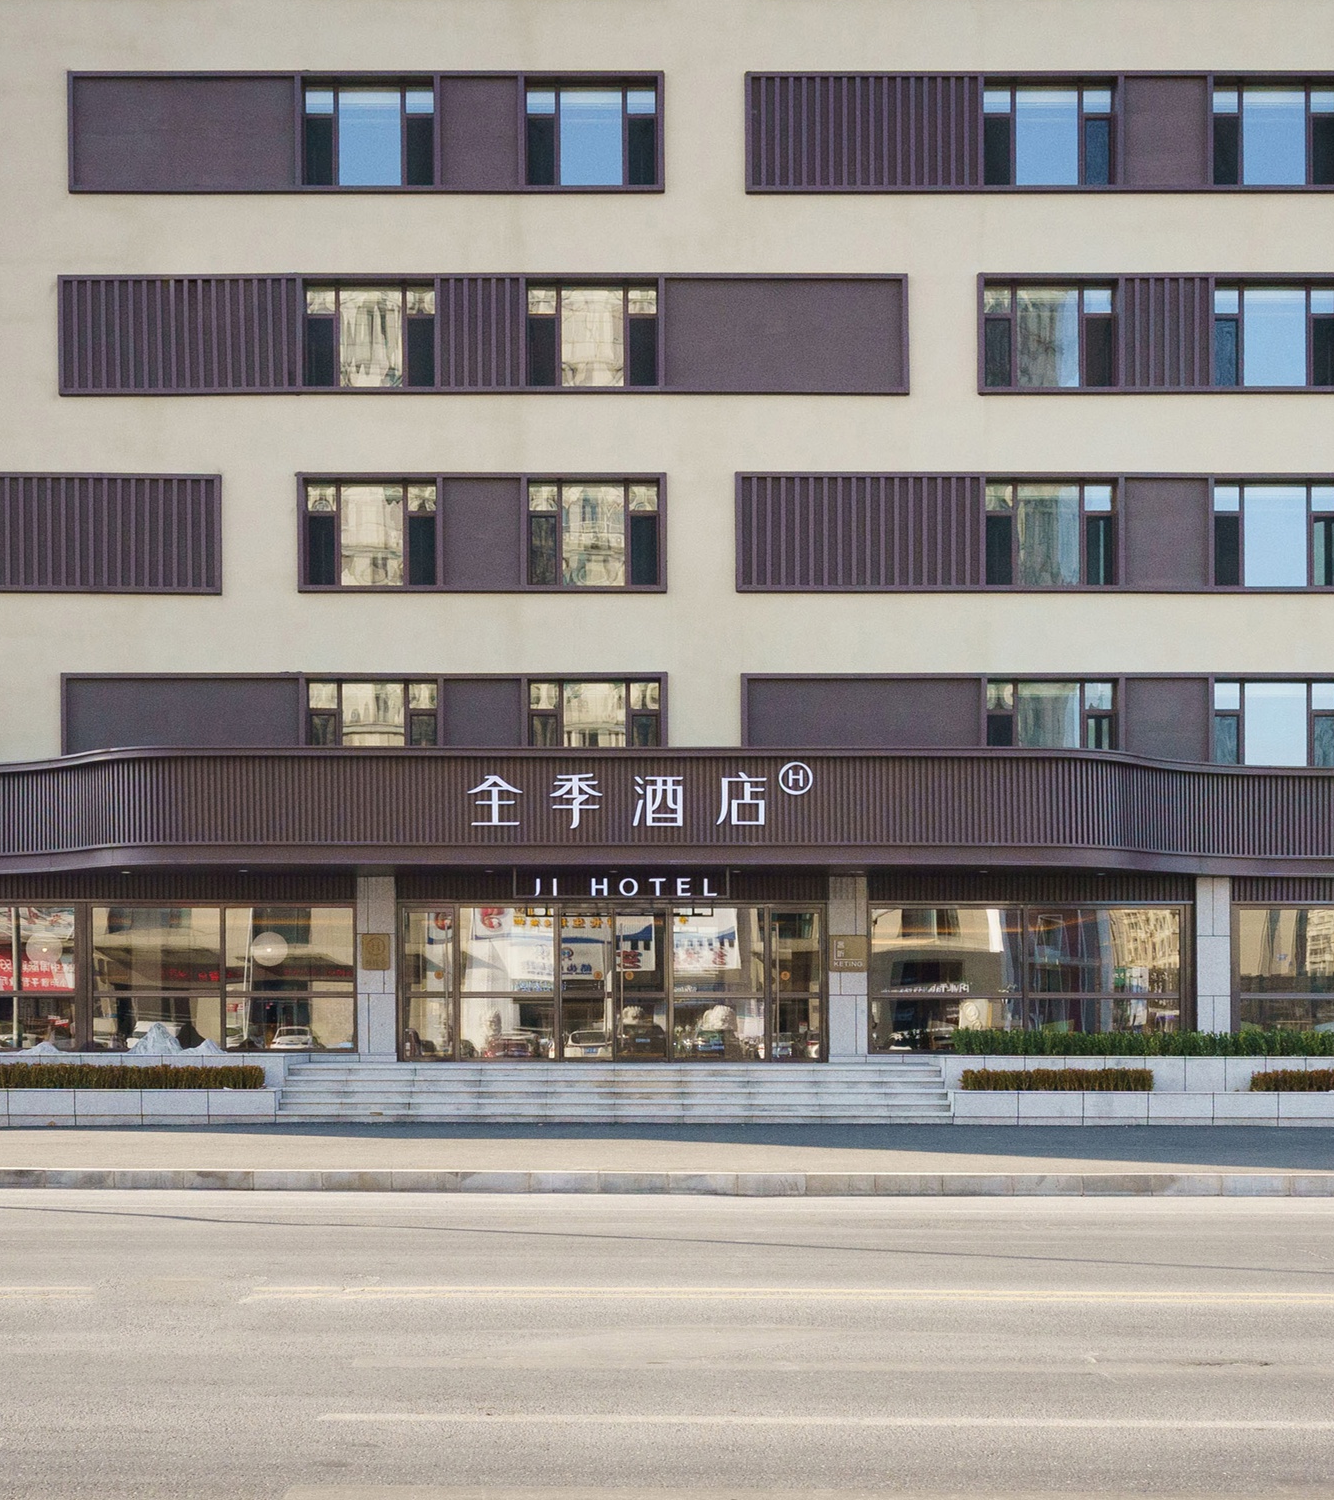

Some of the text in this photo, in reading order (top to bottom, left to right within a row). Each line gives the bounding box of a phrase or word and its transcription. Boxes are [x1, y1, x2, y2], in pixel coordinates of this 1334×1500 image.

[467, 771, 767, 829] 全季酒店
[534, 877, 718, 897] JI HOTEL
